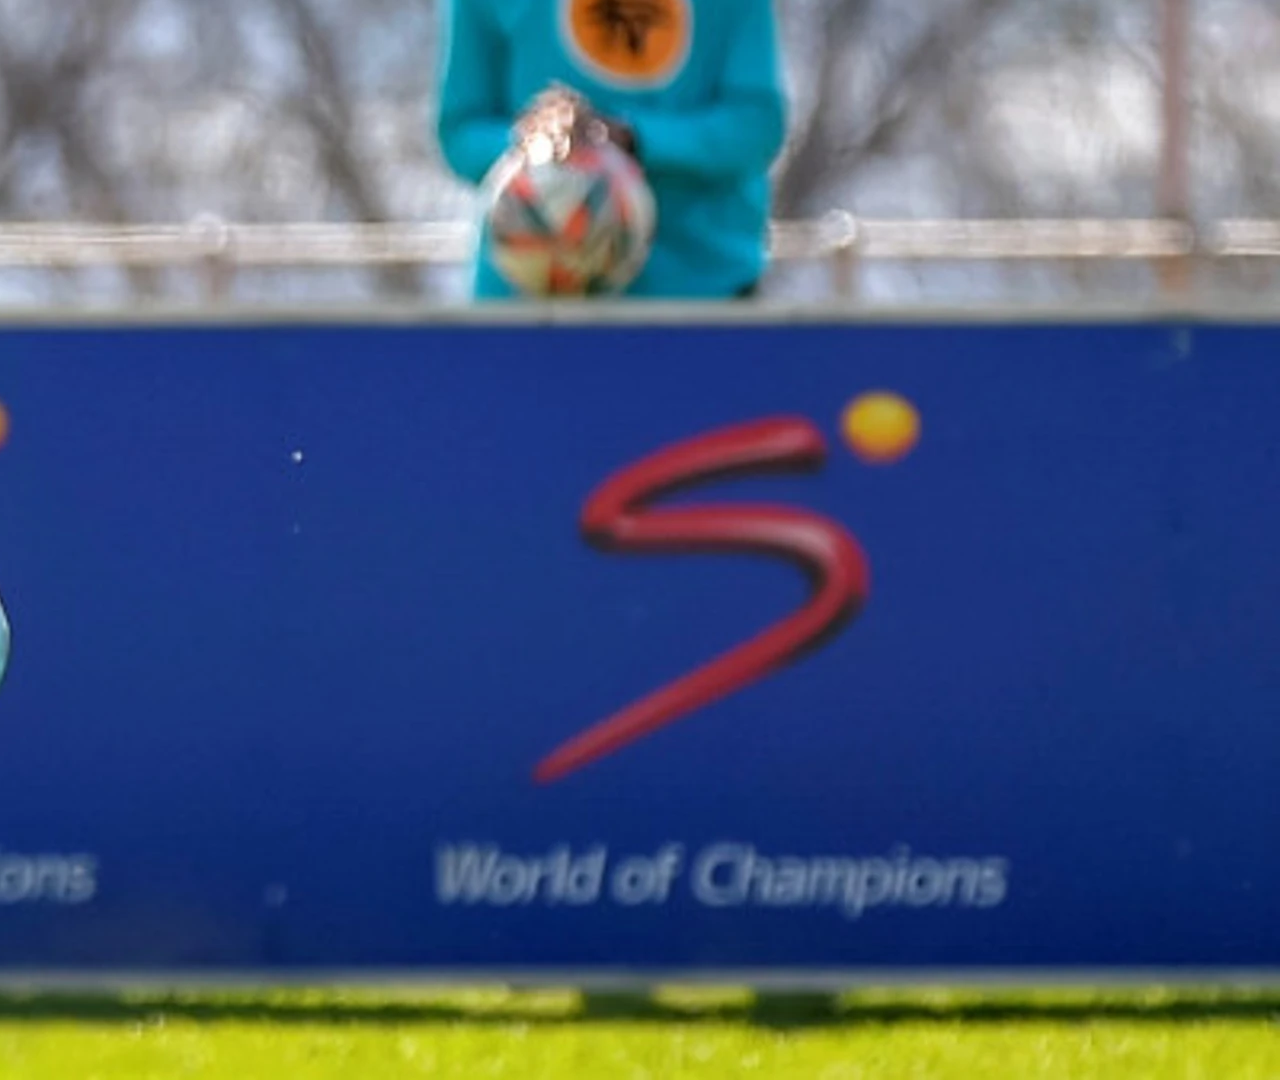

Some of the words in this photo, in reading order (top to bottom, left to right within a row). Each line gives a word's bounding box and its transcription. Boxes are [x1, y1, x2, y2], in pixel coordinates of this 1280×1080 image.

[435, 843, 608, 904] World
[610, 842, 682, 904] of
[690, 841, 1008, 917] Champions
